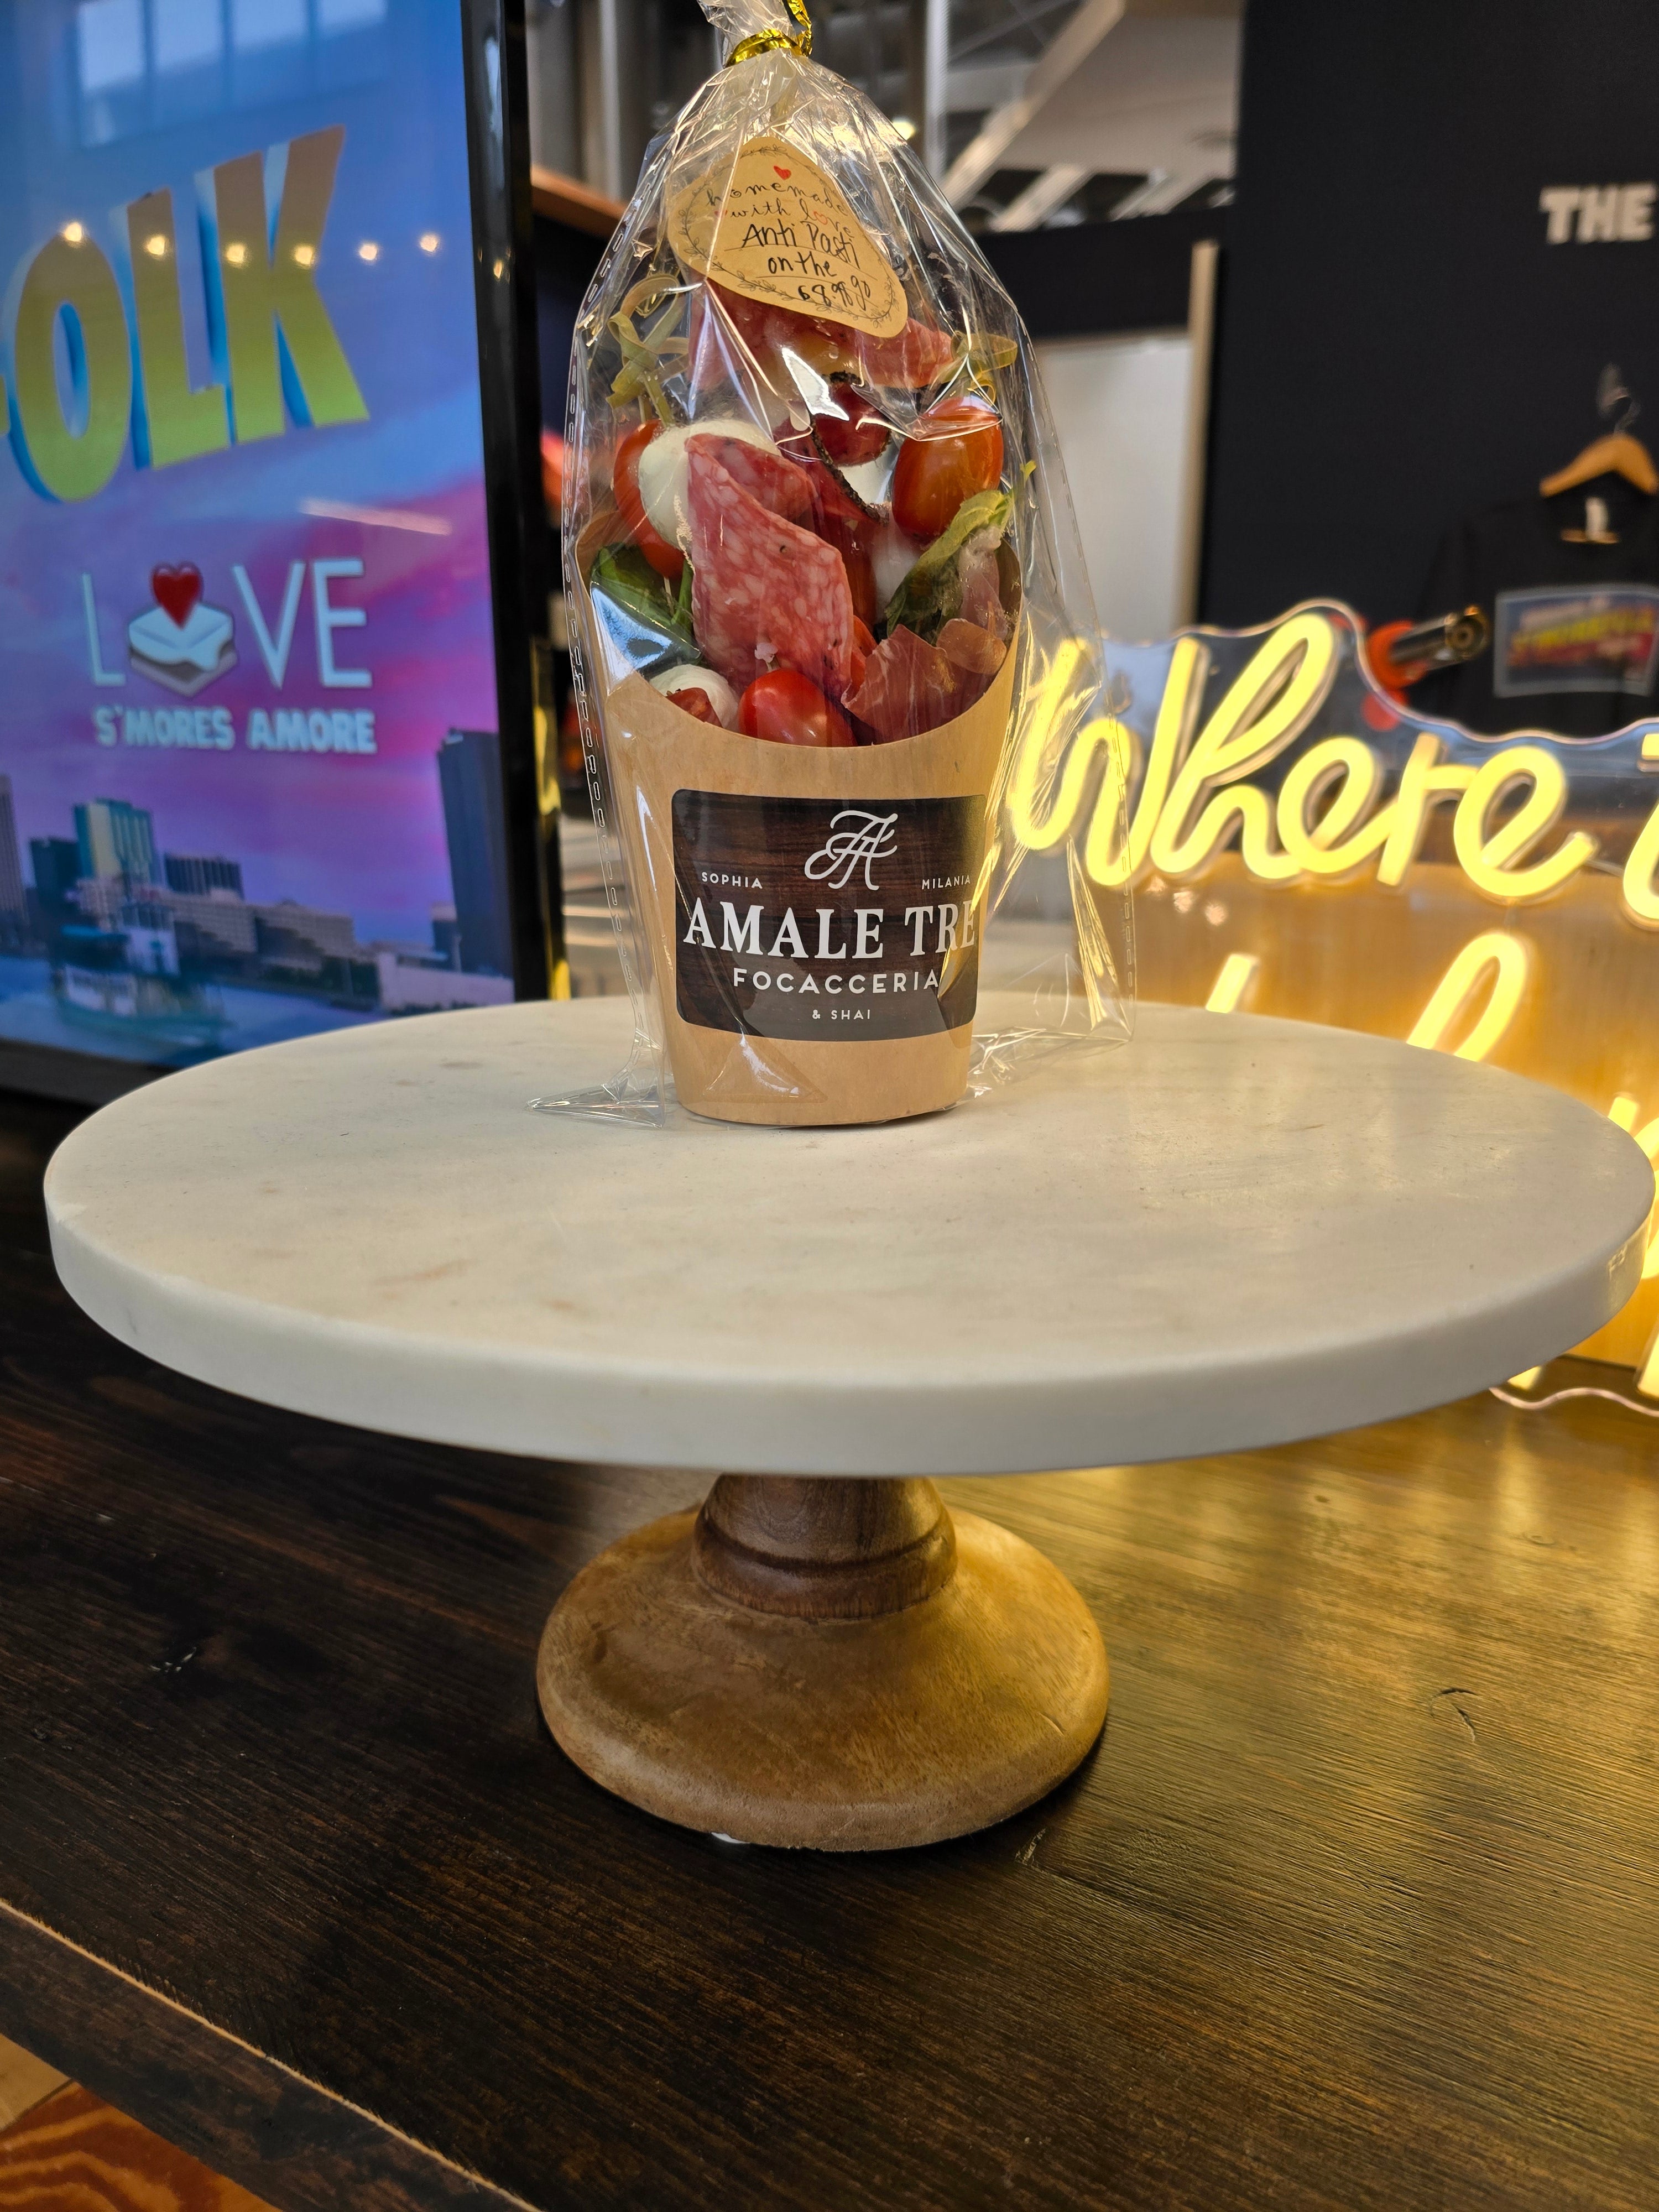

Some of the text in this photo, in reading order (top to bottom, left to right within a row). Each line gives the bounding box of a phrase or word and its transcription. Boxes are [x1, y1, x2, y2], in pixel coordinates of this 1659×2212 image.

[707, 182, 848, 216] homemade
[731, 197, 791, 218] with
[1540, 181, 1656, 244] THE
[768, 251, 837, 277] on the
[0, 124, 369, 503] OLK
[81, 557, 373, 691] LVE
[93, 705, 378, 755] S'MORES AMORE
[1009, 610, 1599, 899] Where
[701, 871, 763, 889] SOPHIA
[921, 875, 972, 890] MILANIA
[683, 896, 975, 959] AMALE TRE
[733, 967, 940, 995] FOCACCERIA
[812, 1009, 872, 1020] & SHAI
